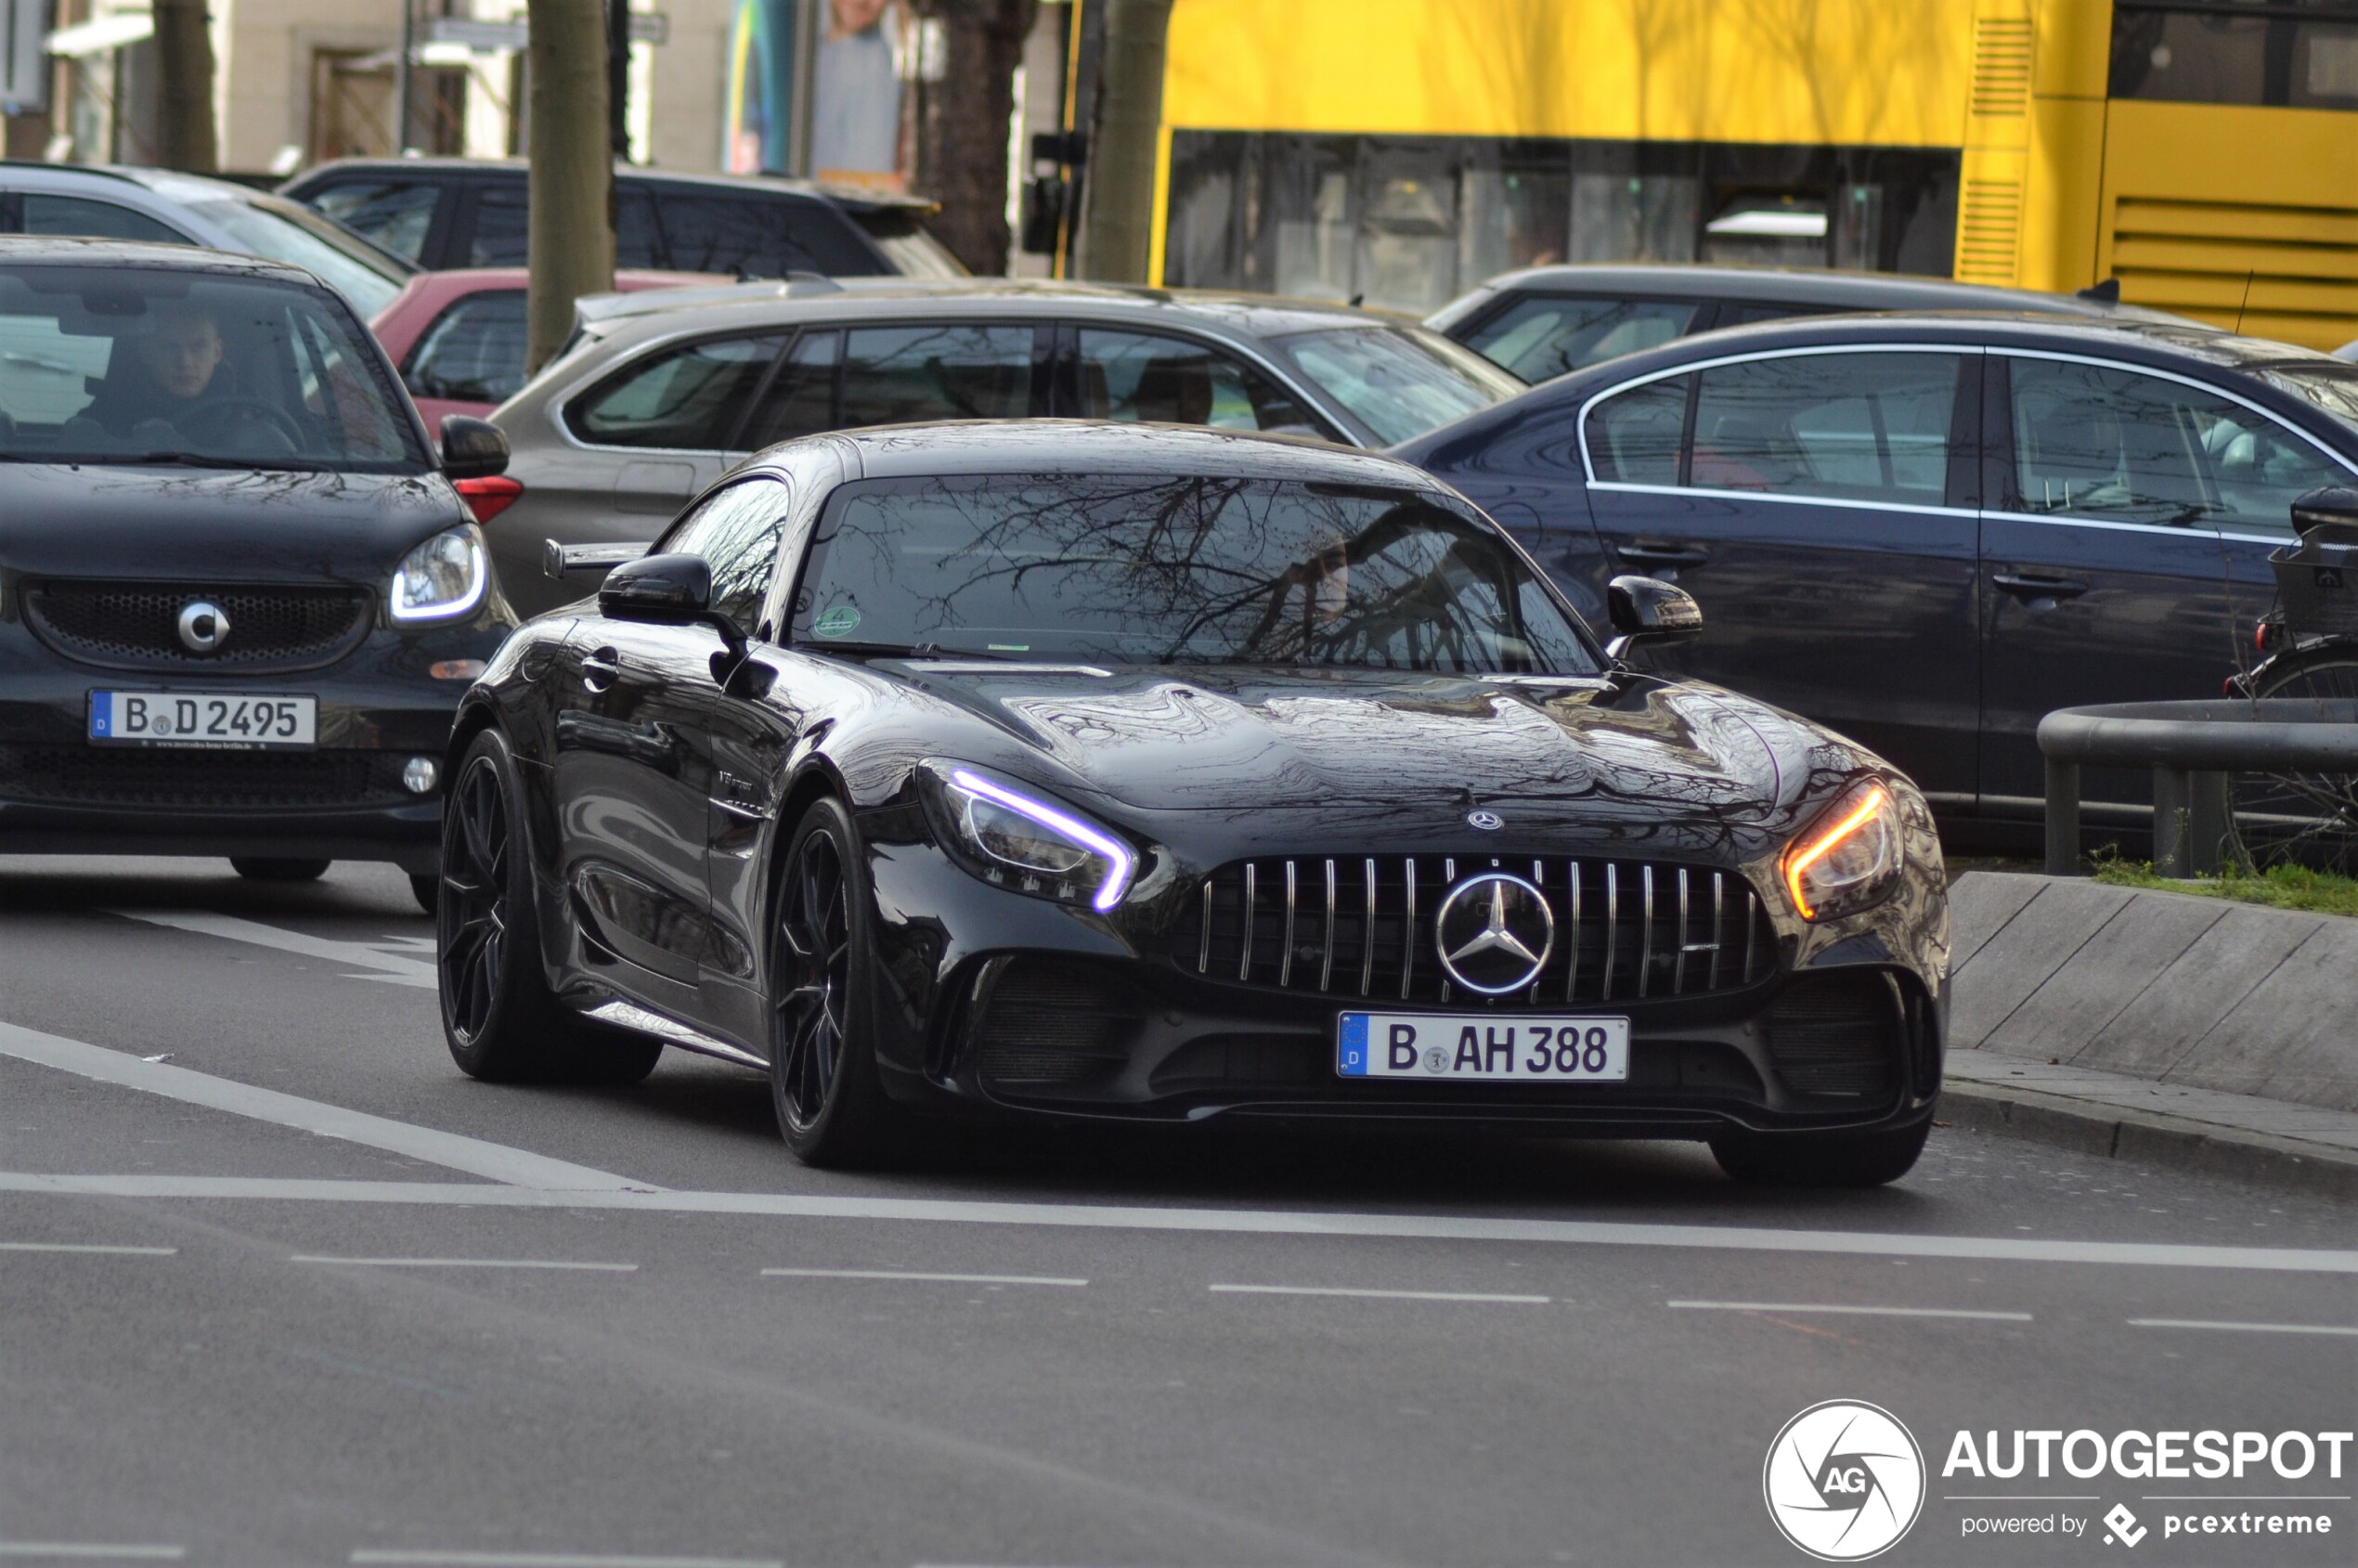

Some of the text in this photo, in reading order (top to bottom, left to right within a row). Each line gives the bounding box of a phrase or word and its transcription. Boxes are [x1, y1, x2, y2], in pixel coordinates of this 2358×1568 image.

[97, 719, 106, 730] D
[126, 698, 297, 737] B D 2495
[1349, 1052, 1359, 1065] D
[1388, 1024, 1607, 1073] B AH 388
